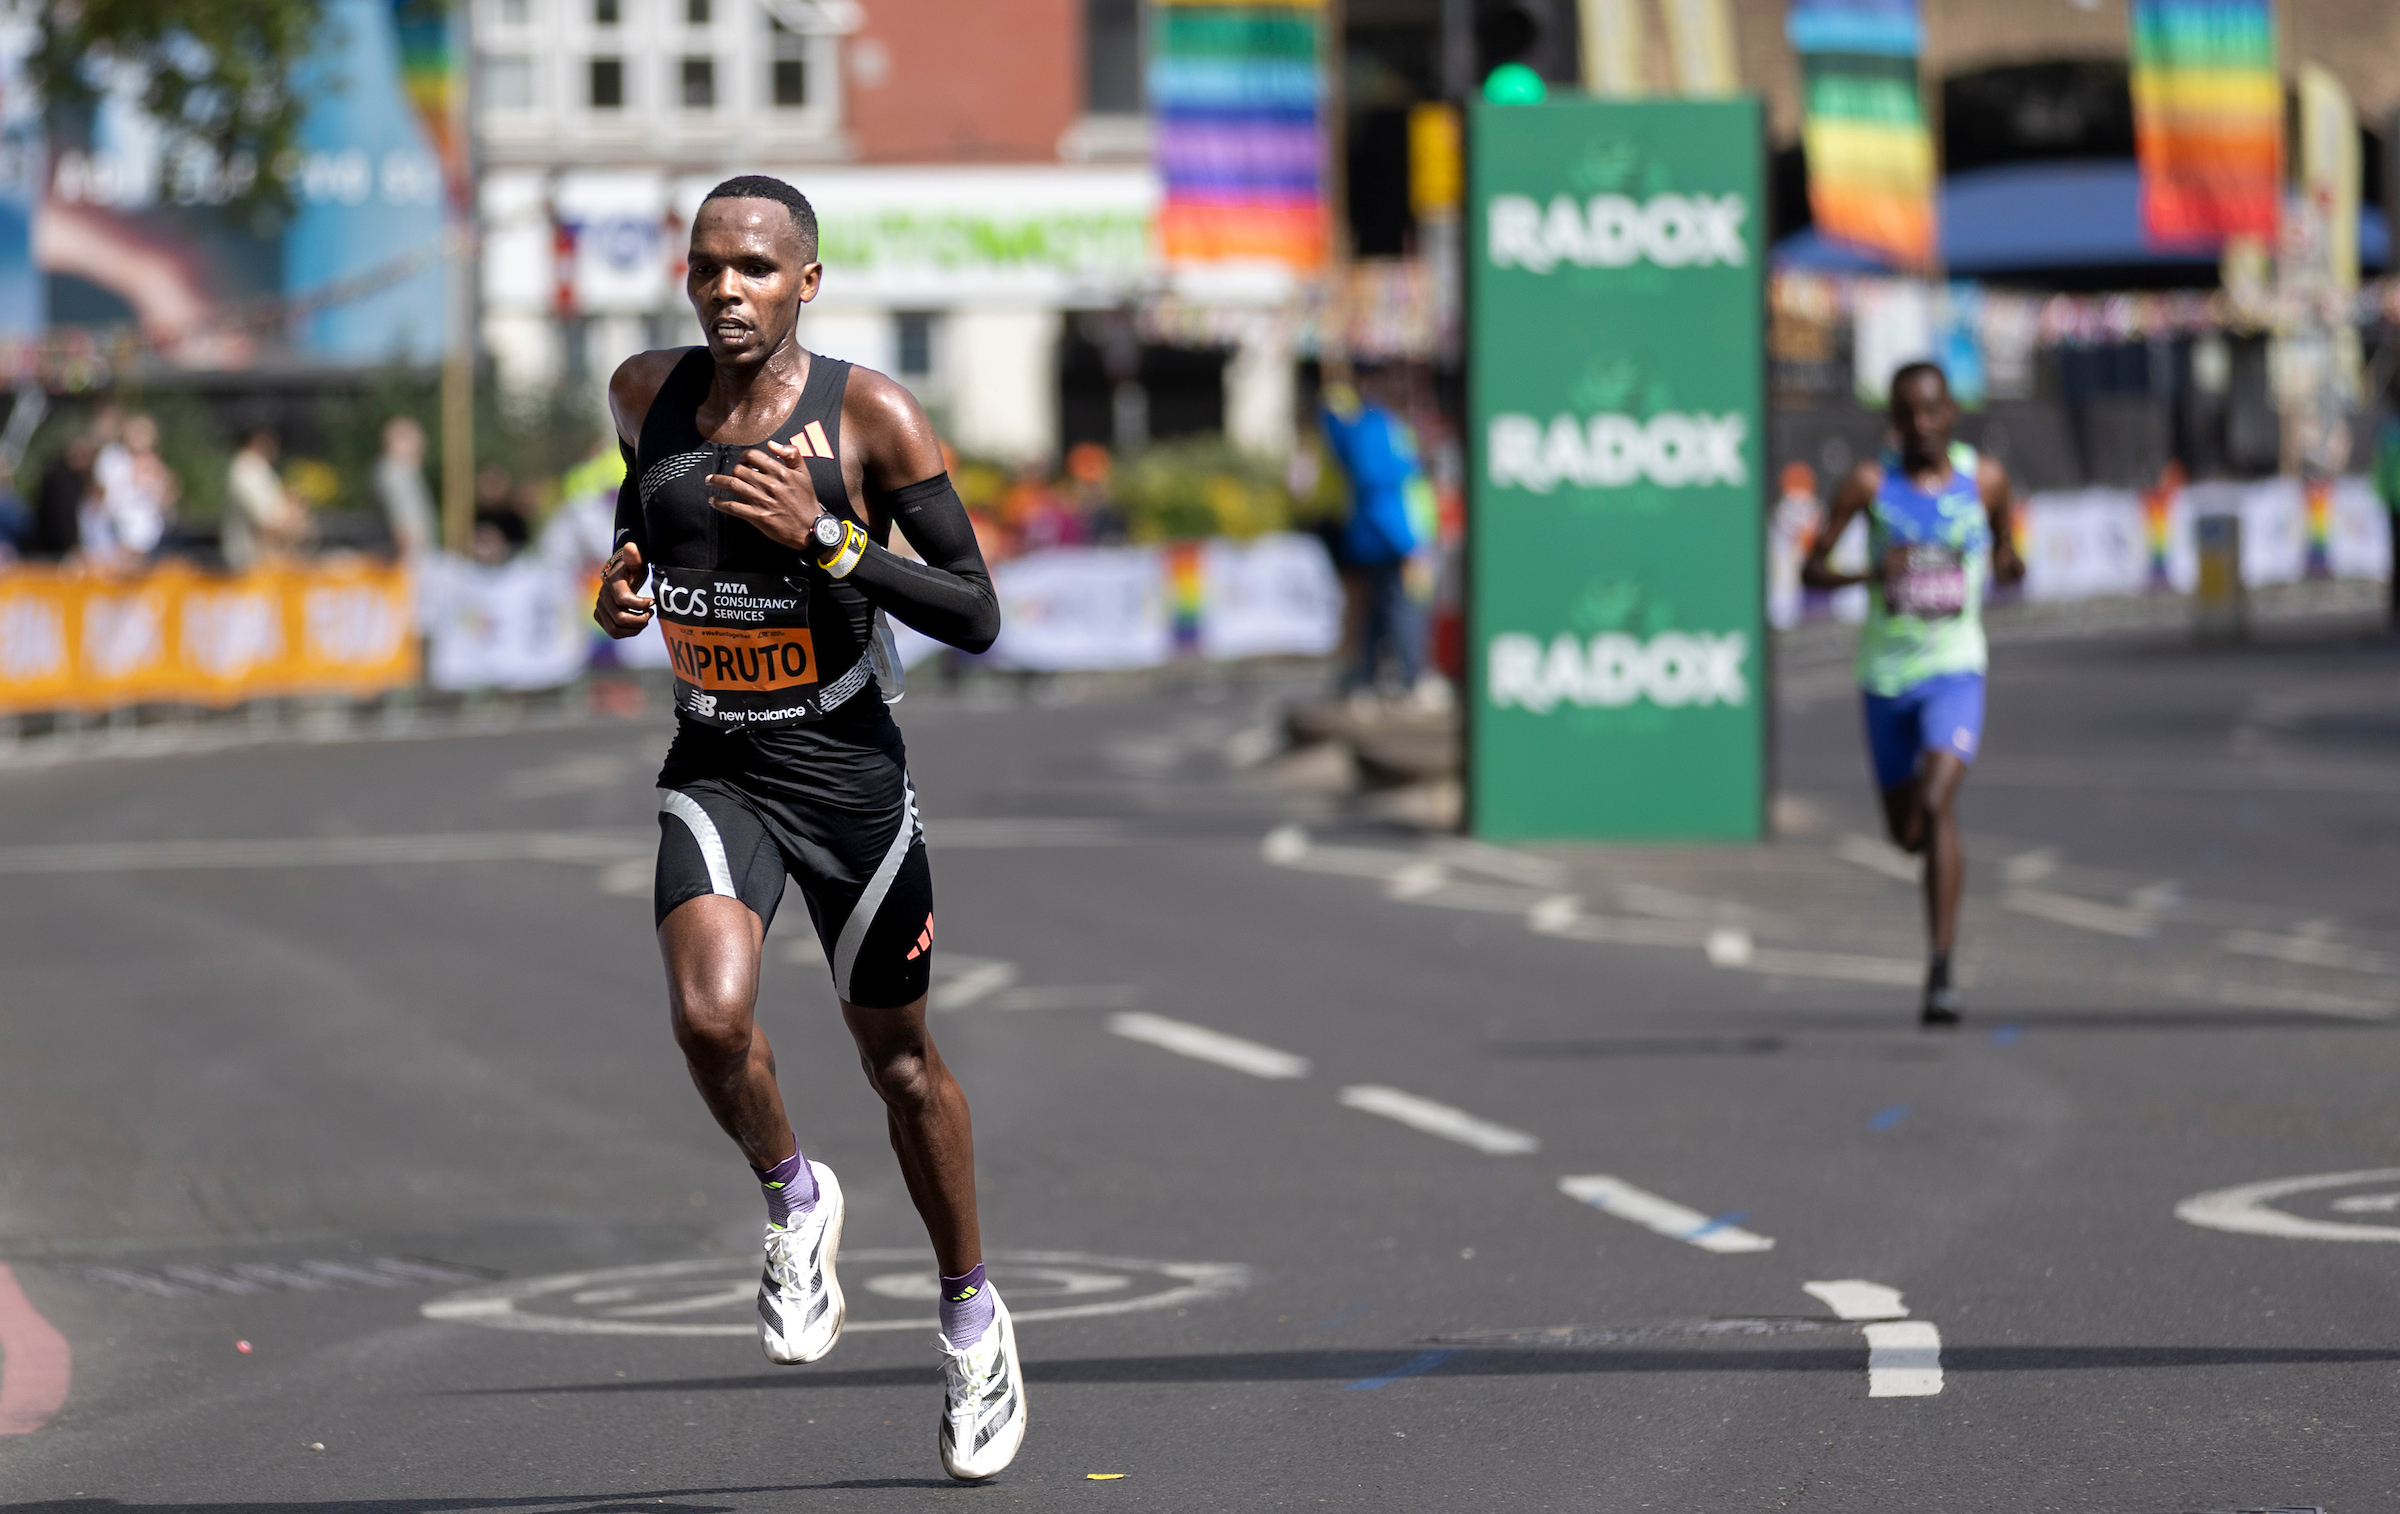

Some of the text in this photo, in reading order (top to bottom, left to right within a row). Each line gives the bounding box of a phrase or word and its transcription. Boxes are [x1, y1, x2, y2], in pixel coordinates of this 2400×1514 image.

[1487, 193, 1748, 276] RADOX
[1487, 412, 1748, 494] RADOX
[659, 577, 708, 617] tcs
[713, 595, 797, 609] CONSULTANCY
[714, 582, 748, 594] TATA
[714, 608, 765, 621] SERVICES
[669, 636, 807, 682] KIPRUTO
[1487, 630, 1748, 716] RADOX
[719, 706, 806, 721] new balance
